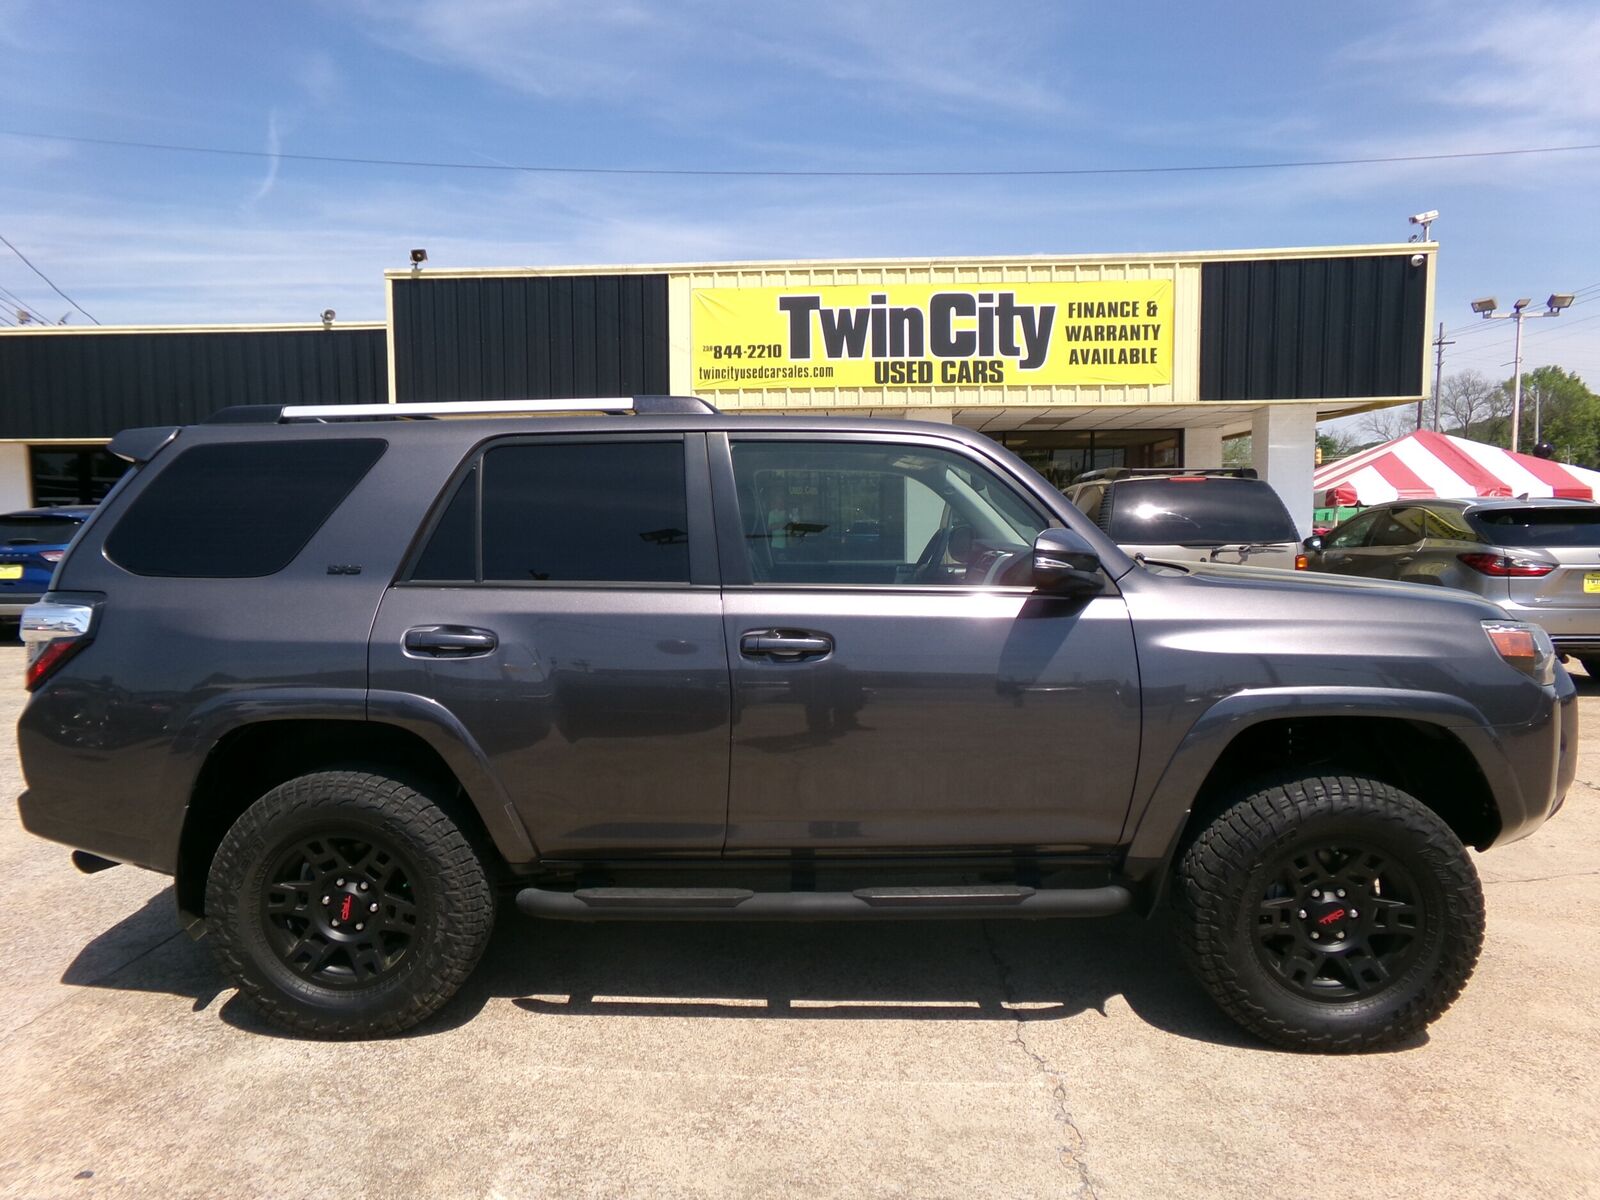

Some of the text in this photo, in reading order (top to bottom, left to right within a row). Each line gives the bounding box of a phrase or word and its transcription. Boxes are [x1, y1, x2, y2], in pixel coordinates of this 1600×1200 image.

[1068, 301, 1158, 318] FINANCE &
[1065, 324, 1161, 341] WARRANTY
[1069, 348, 1158, 365] AVAILABLE
[699, 365, 834, 381] twincityusedcarsales.com
[874, 360, 1004, 384] USED CARS
[1319, 909, 1345, 925] TRD
